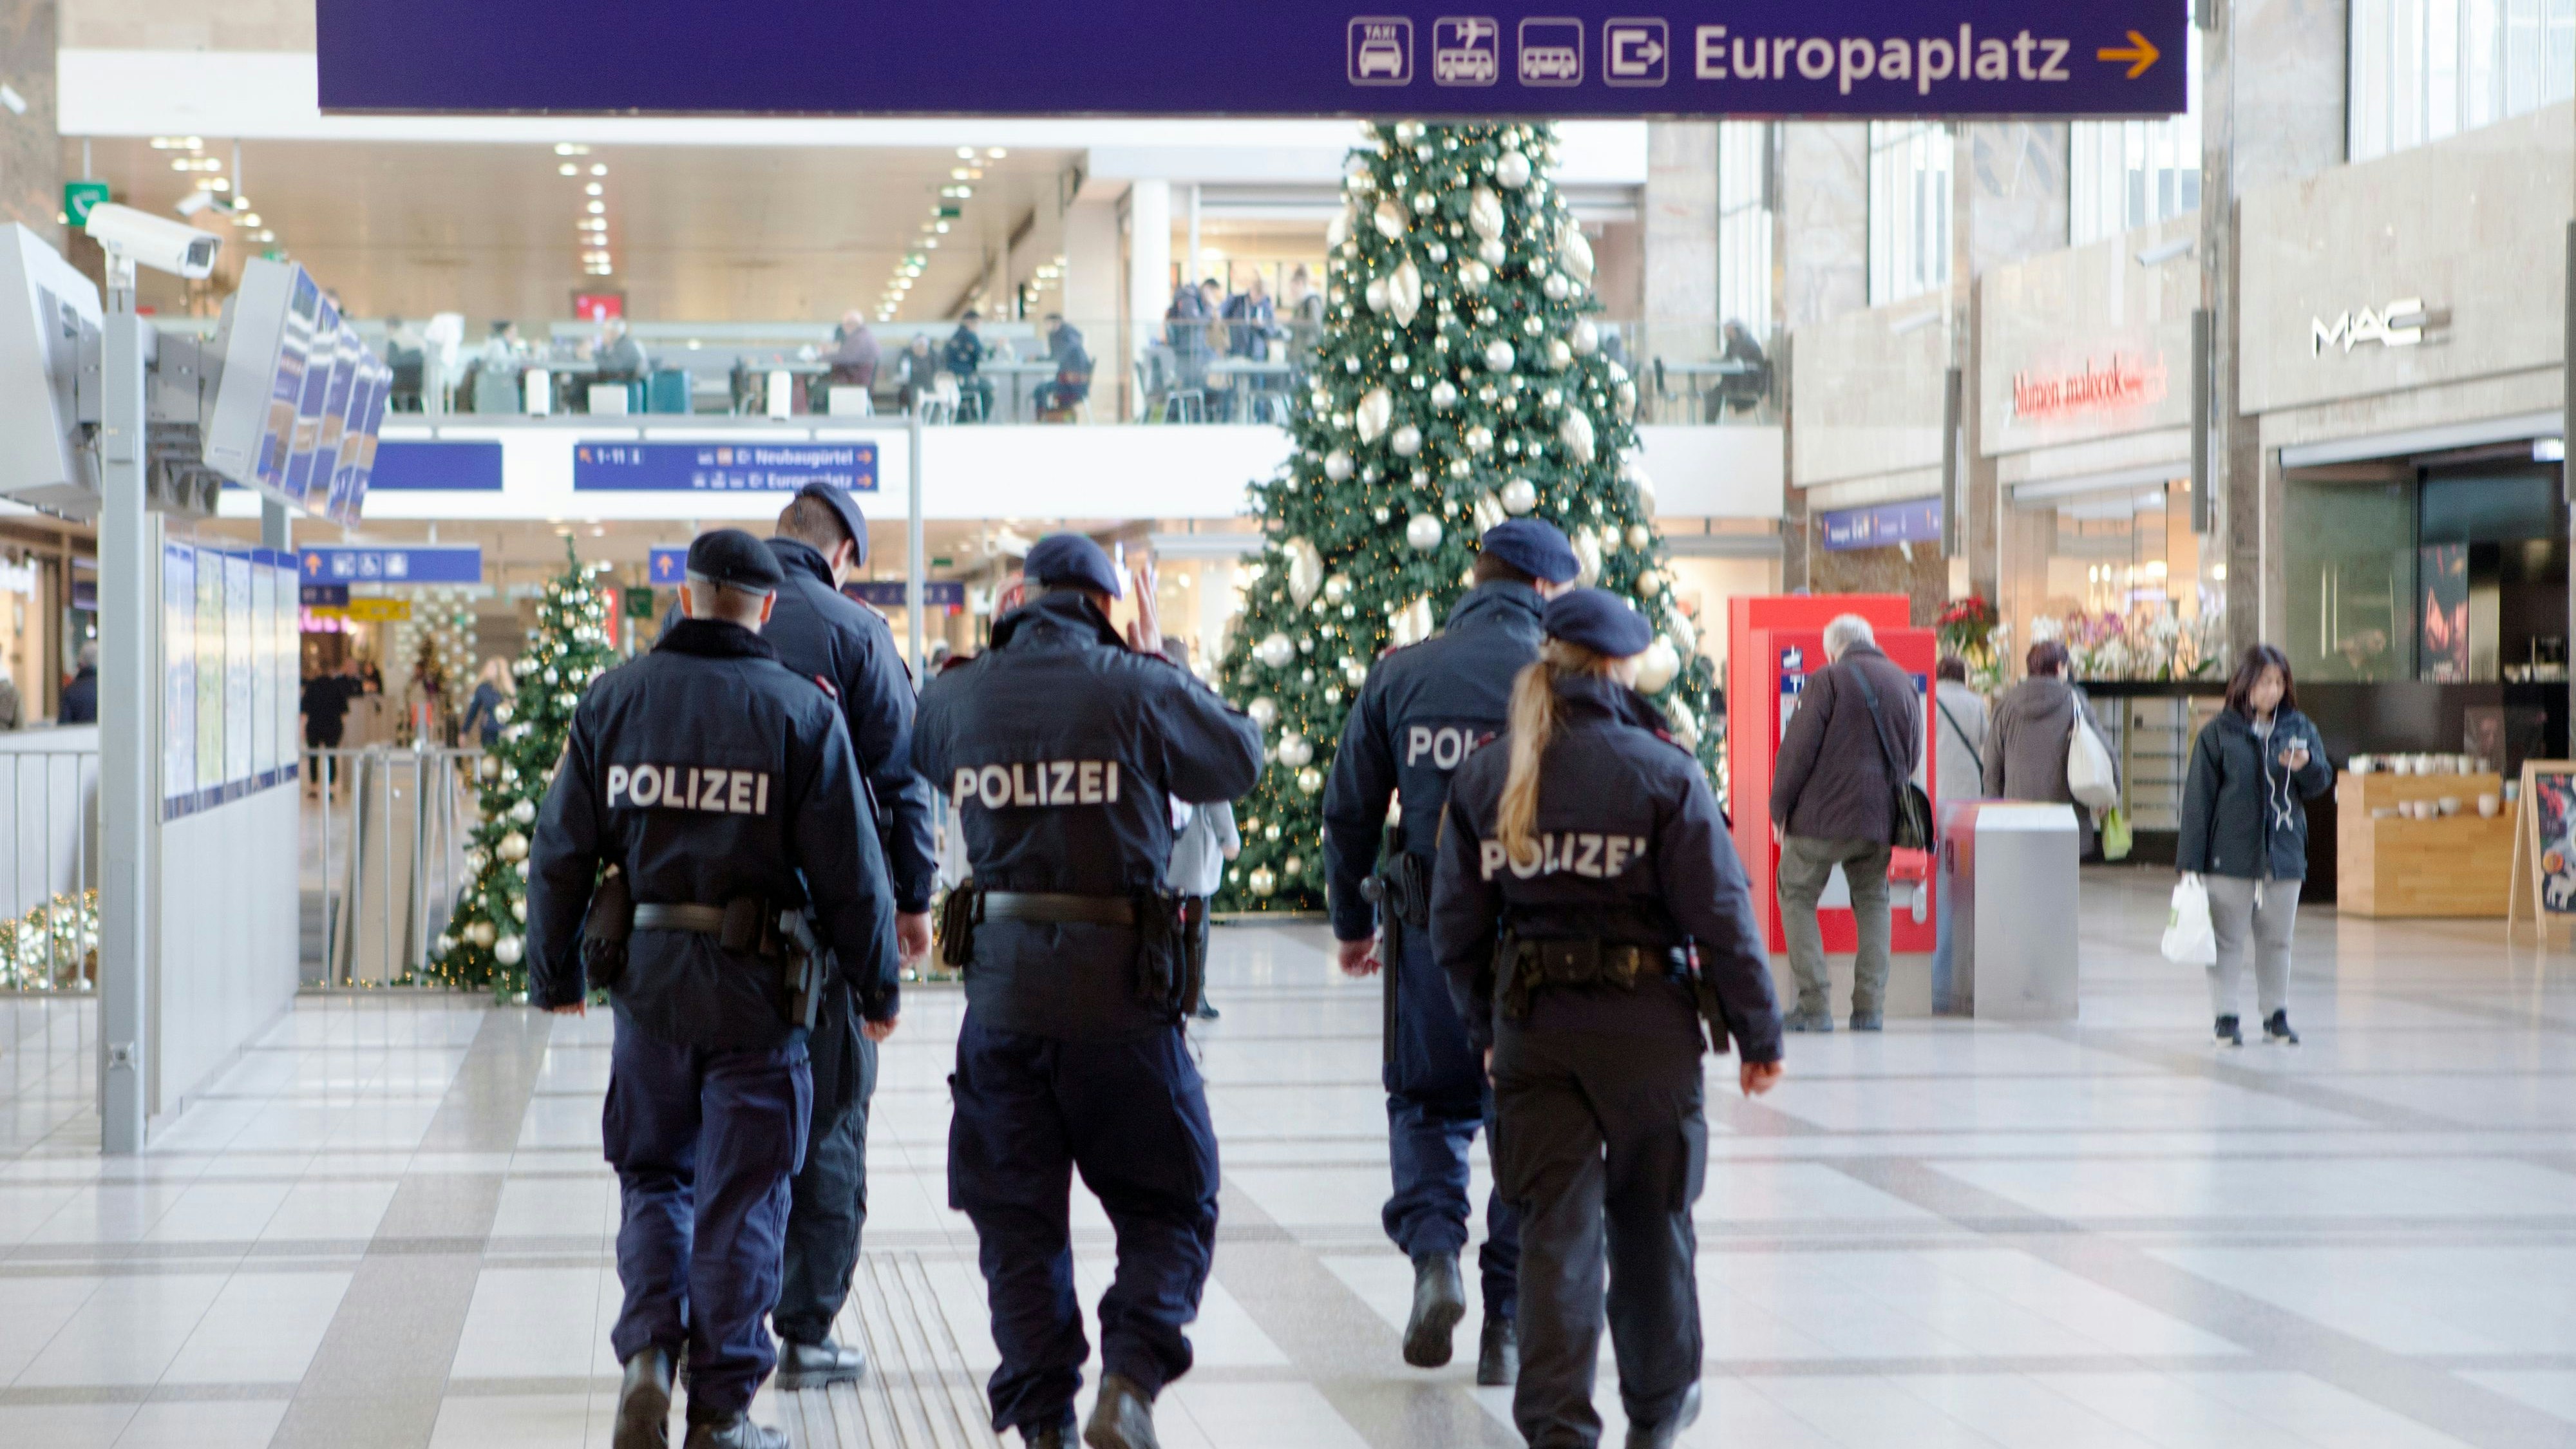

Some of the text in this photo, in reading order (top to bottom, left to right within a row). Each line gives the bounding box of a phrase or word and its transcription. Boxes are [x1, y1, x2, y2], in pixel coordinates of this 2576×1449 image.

[1364, 24, 1397, 40] TAXI
[1695, 23, 2070, 95] Europaplatz
[755, 448, 854, 469] Neubaugürtel
[607, 764, 769, 815] POLIZEI
[951, 760, 1119, 810] POLIZEI
